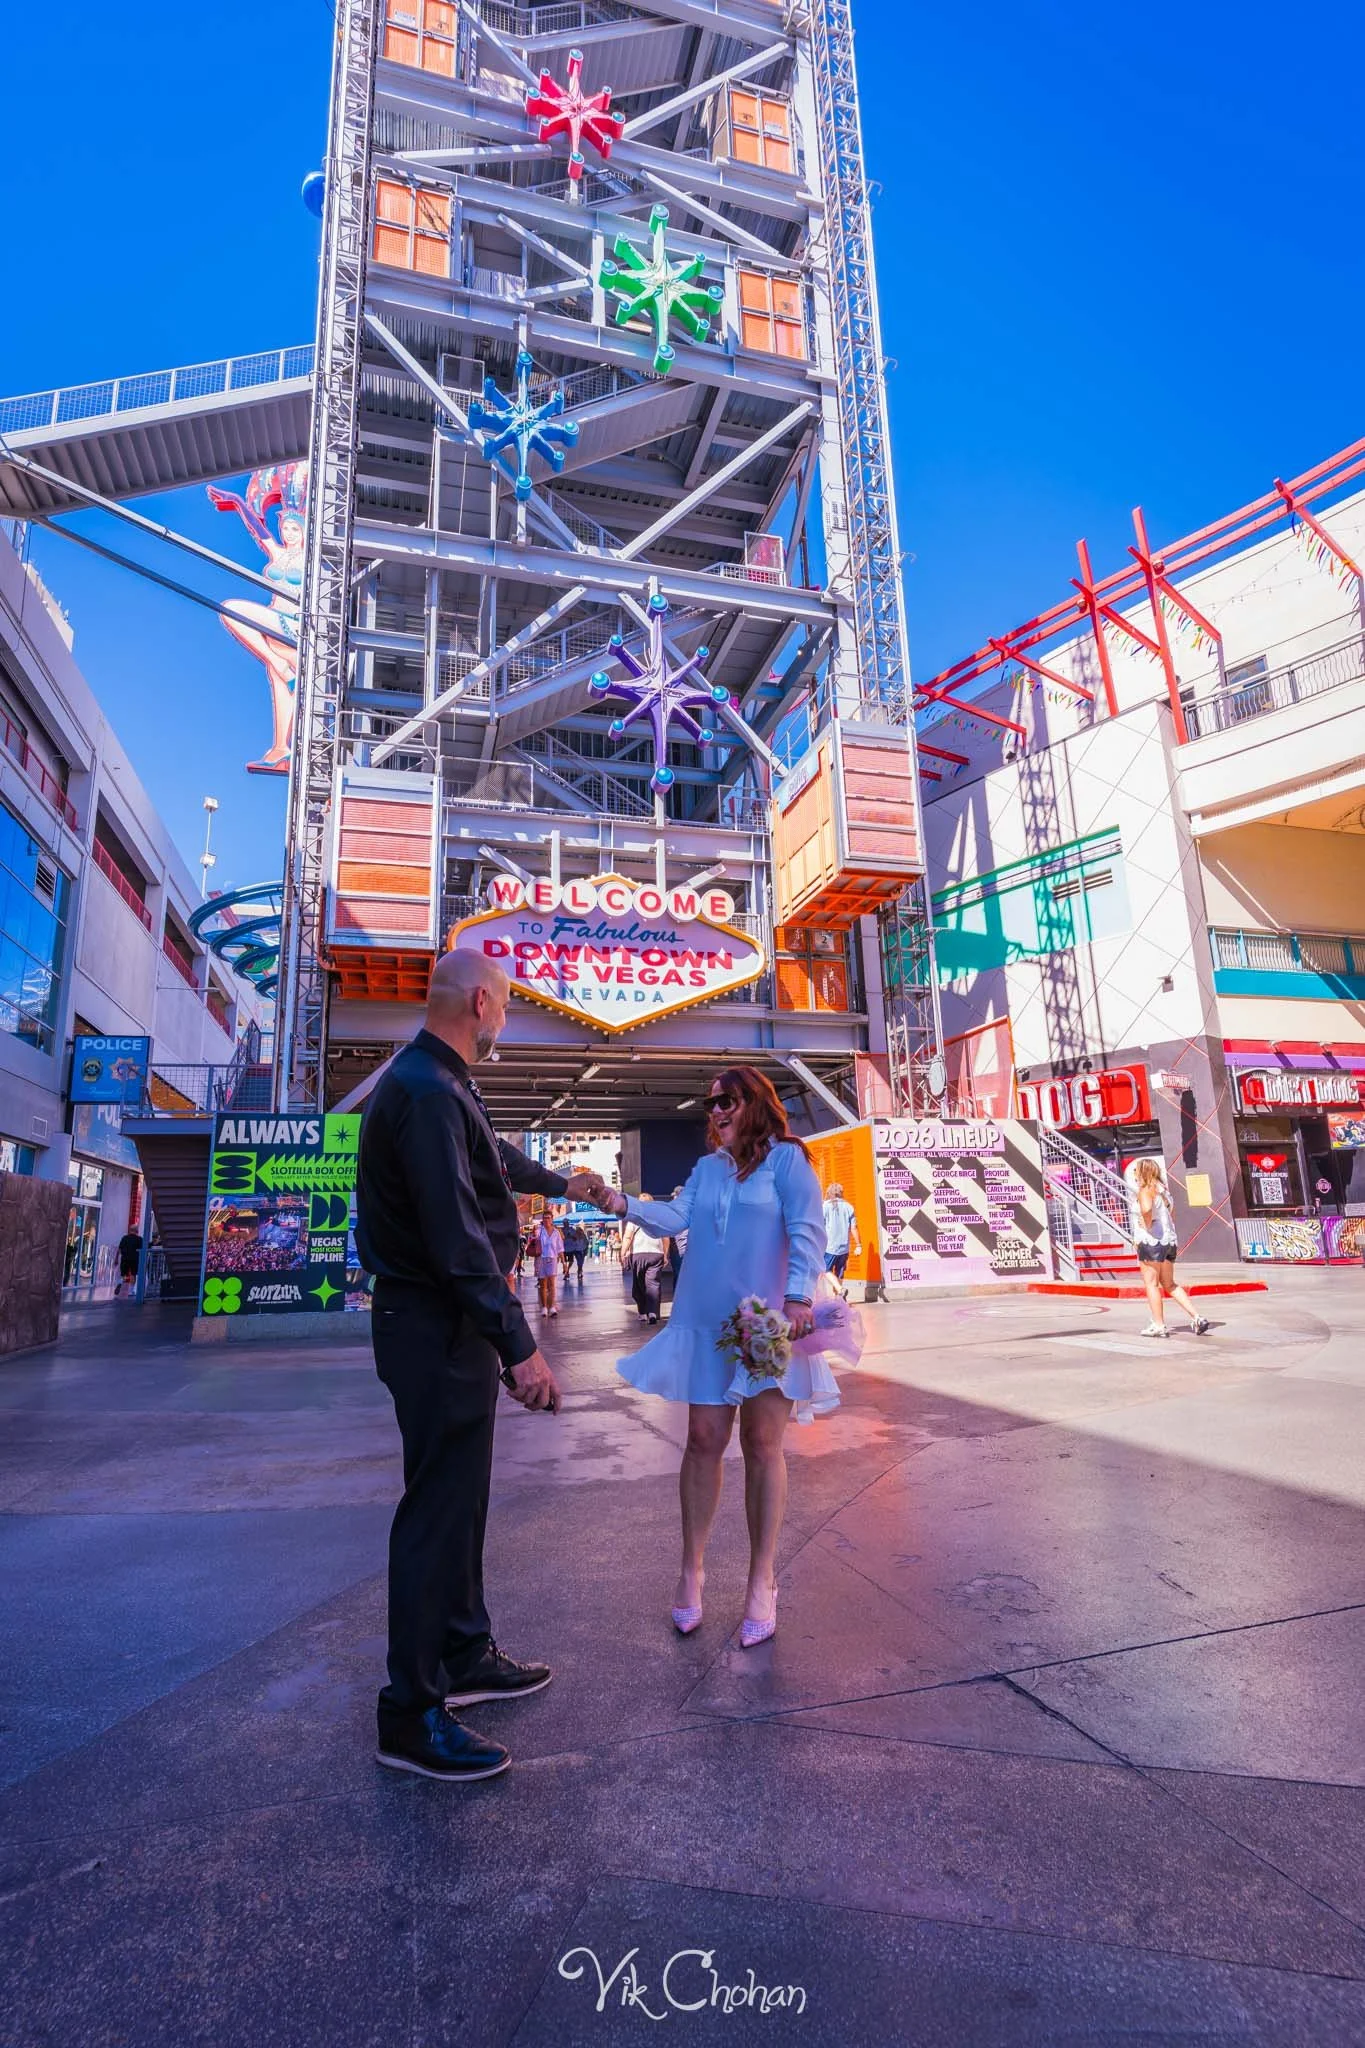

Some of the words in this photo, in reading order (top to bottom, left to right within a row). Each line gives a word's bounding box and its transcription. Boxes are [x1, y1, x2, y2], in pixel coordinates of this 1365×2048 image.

[493, 879, 727, 917] WELCOME
[518, 921, 543, 935] TO
[551, 917, 684, 943] Fabulous
[483, 939, 733, 970] DOWNTOWN
[515, 961, 579, 981] LAS
[592, 965, 707, 987] VEGAS
[563, 987, 664, 1004] NEVADA
[81, 1038, 142, 1051] POLICE
[218, 1119, 320, 1145] ALWAYS
[880, 1127, 935, 1149] 2026
[938, 1127, 1001, 1149] LINEUP
[270, 1166, 313, 1175] SLOTZILLA
[315, 1166, 334, 1175] BOX
[336, 1166, 356, 1175] OFFI
[932, 1170, 958, 1178] GEORGE
[933, 1189, 960, 1197] SLEEPING
[986, 1185, 1003, 1193] CARLY
[1004, 1185, 1025, 1193] PEARCE
[886, 1200, 922, 1208] CROSSFADE
[936, 1215, 960, 1224] MAYDAY
[960, 1215, 983, 1223] PARADE
[887, 1226, 901, 1234] FUEL
[311, 1237, 345, 1247] VEGAS'
[937, 1234, 957, 1243] STORY
[957, 1234, 967, 1242] OF
[889, 1244, 911, 1253] FINGER
[911, 1244, 932, 1252] ELEVEN
[938, 1243, 949, 1251] THE
[310, 1253, 345, 1263] ZIPLINE
[992, 1248, 1032, 1260] SUMMER
[989, 1259, 1018, 1269] CONCERT
[1018, 1258, 1040, 1268] SERIES
